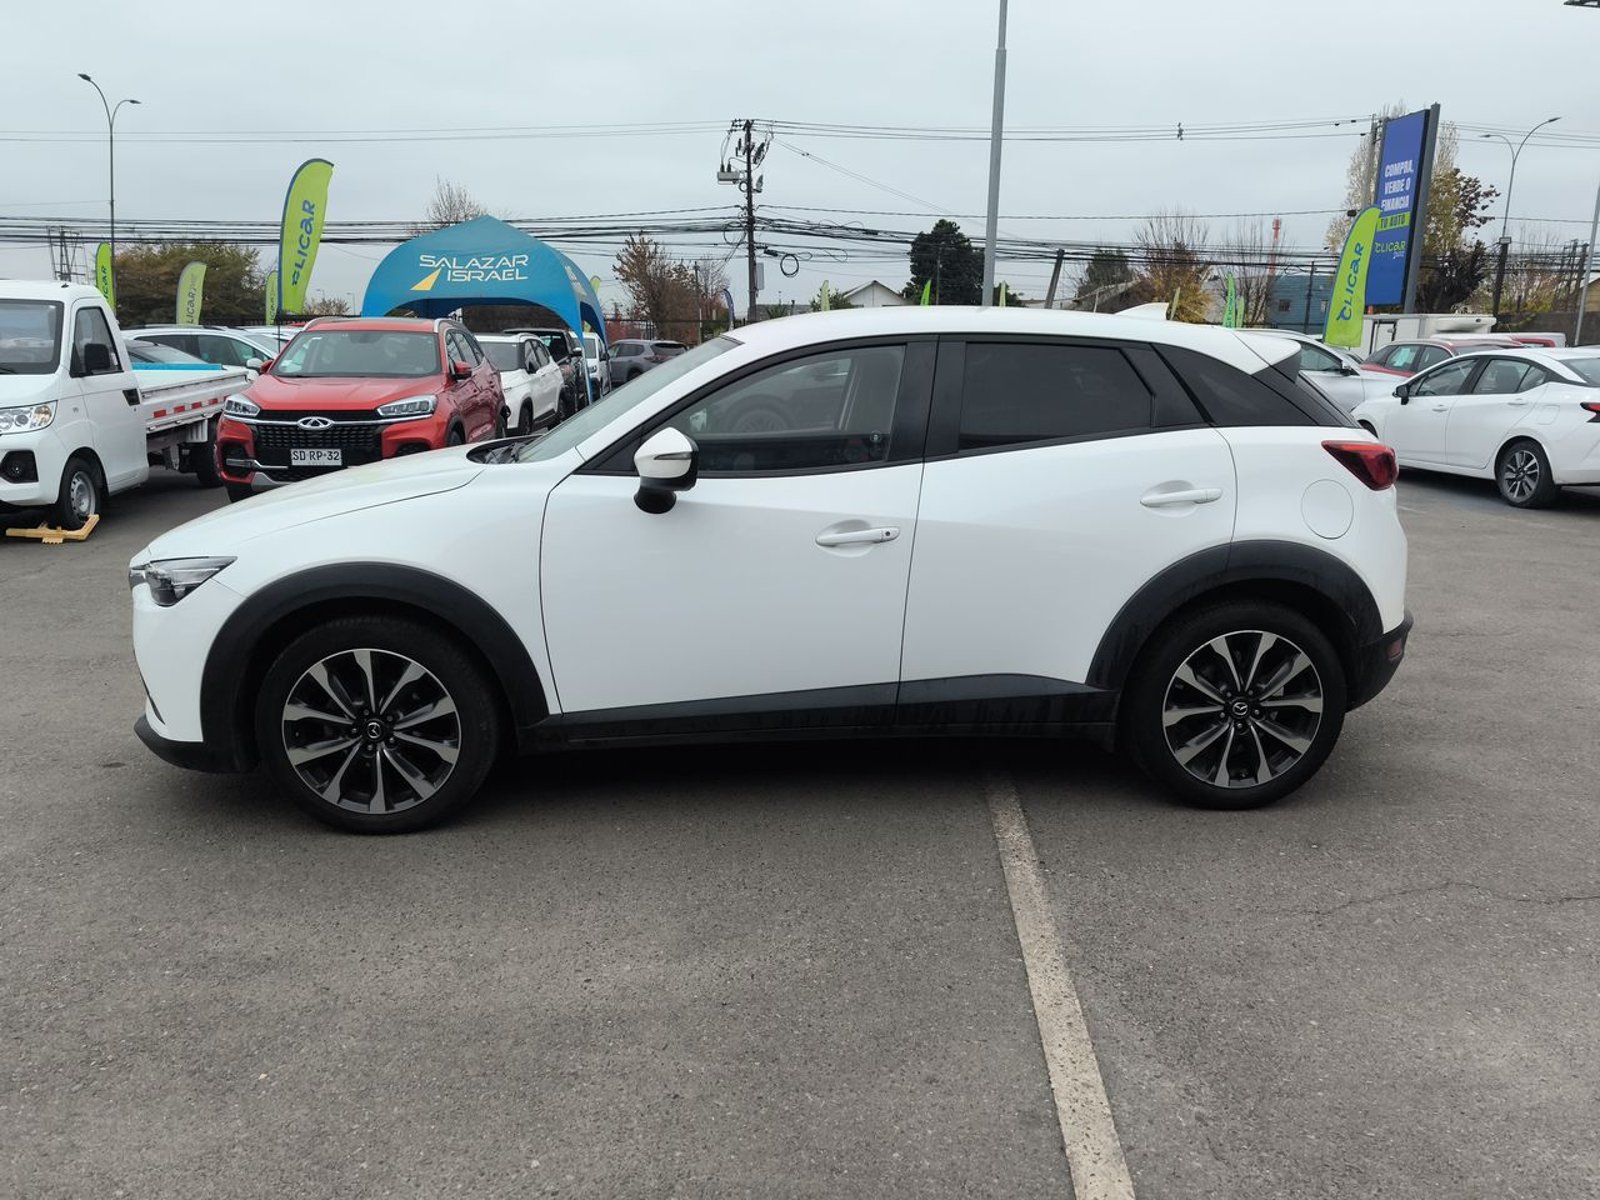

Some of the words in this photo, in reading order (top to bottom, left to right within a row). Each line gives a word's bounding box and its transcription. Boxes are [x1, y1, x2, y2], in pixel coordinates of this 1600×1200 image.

[1384, 178, 1406, 195] VENDE
[1405, 177, 1411, 191] O
[1381, 195, 1410, 212] FINANCIA
[1380, 217, 1388, 229] TU
[1389, 214, 1405, 227] AUTO
[419, 254, 529, 269] SALAZAR
[447, 268, 529, 282] ISRAEL
